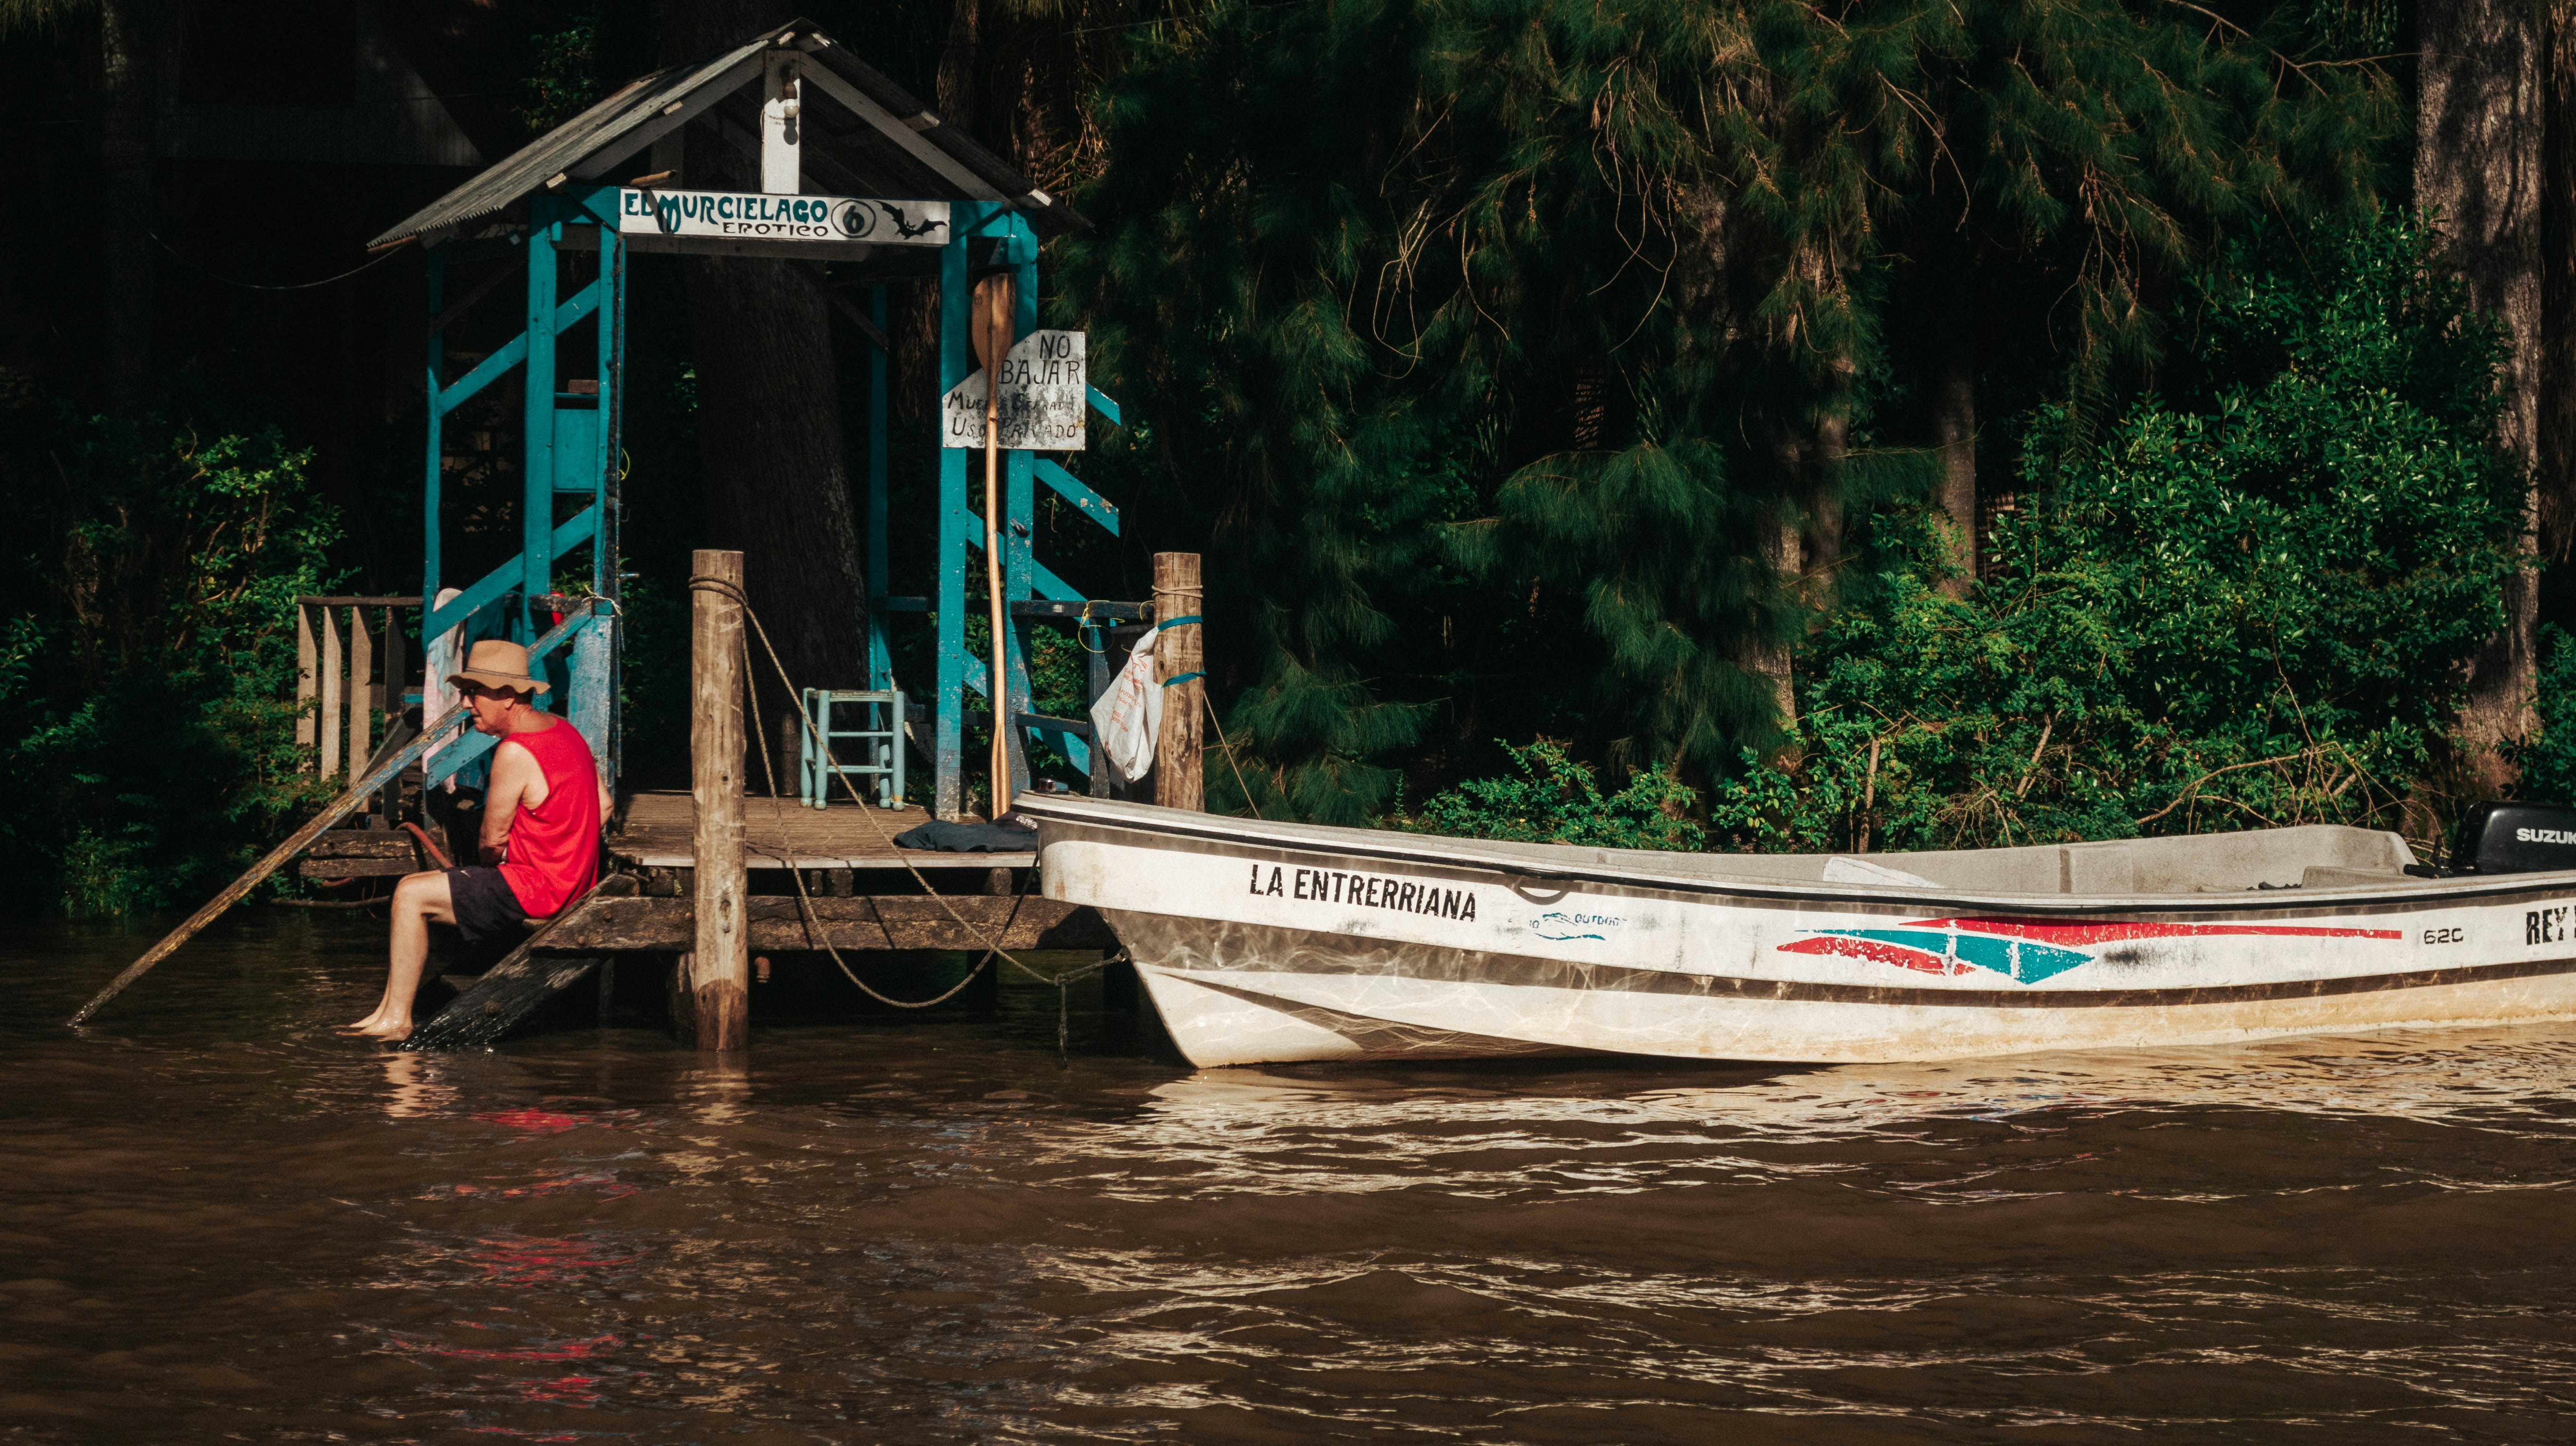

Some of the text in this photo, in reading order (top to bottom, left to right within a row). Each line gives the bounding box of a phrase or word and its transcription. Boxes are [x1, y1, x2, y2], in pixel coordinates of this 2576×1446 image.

[625, 193, 828, 233] EL MURCIELAGO
[723, 222, 829, 237] EROTICO
[1039, 335, 1071, 359] NO
[998, 360, 1080, 385] BAJAR
[1250, 864, 1476, 922] LA ENTRERRIANA
[2526, 907, 2568, 946] REY
